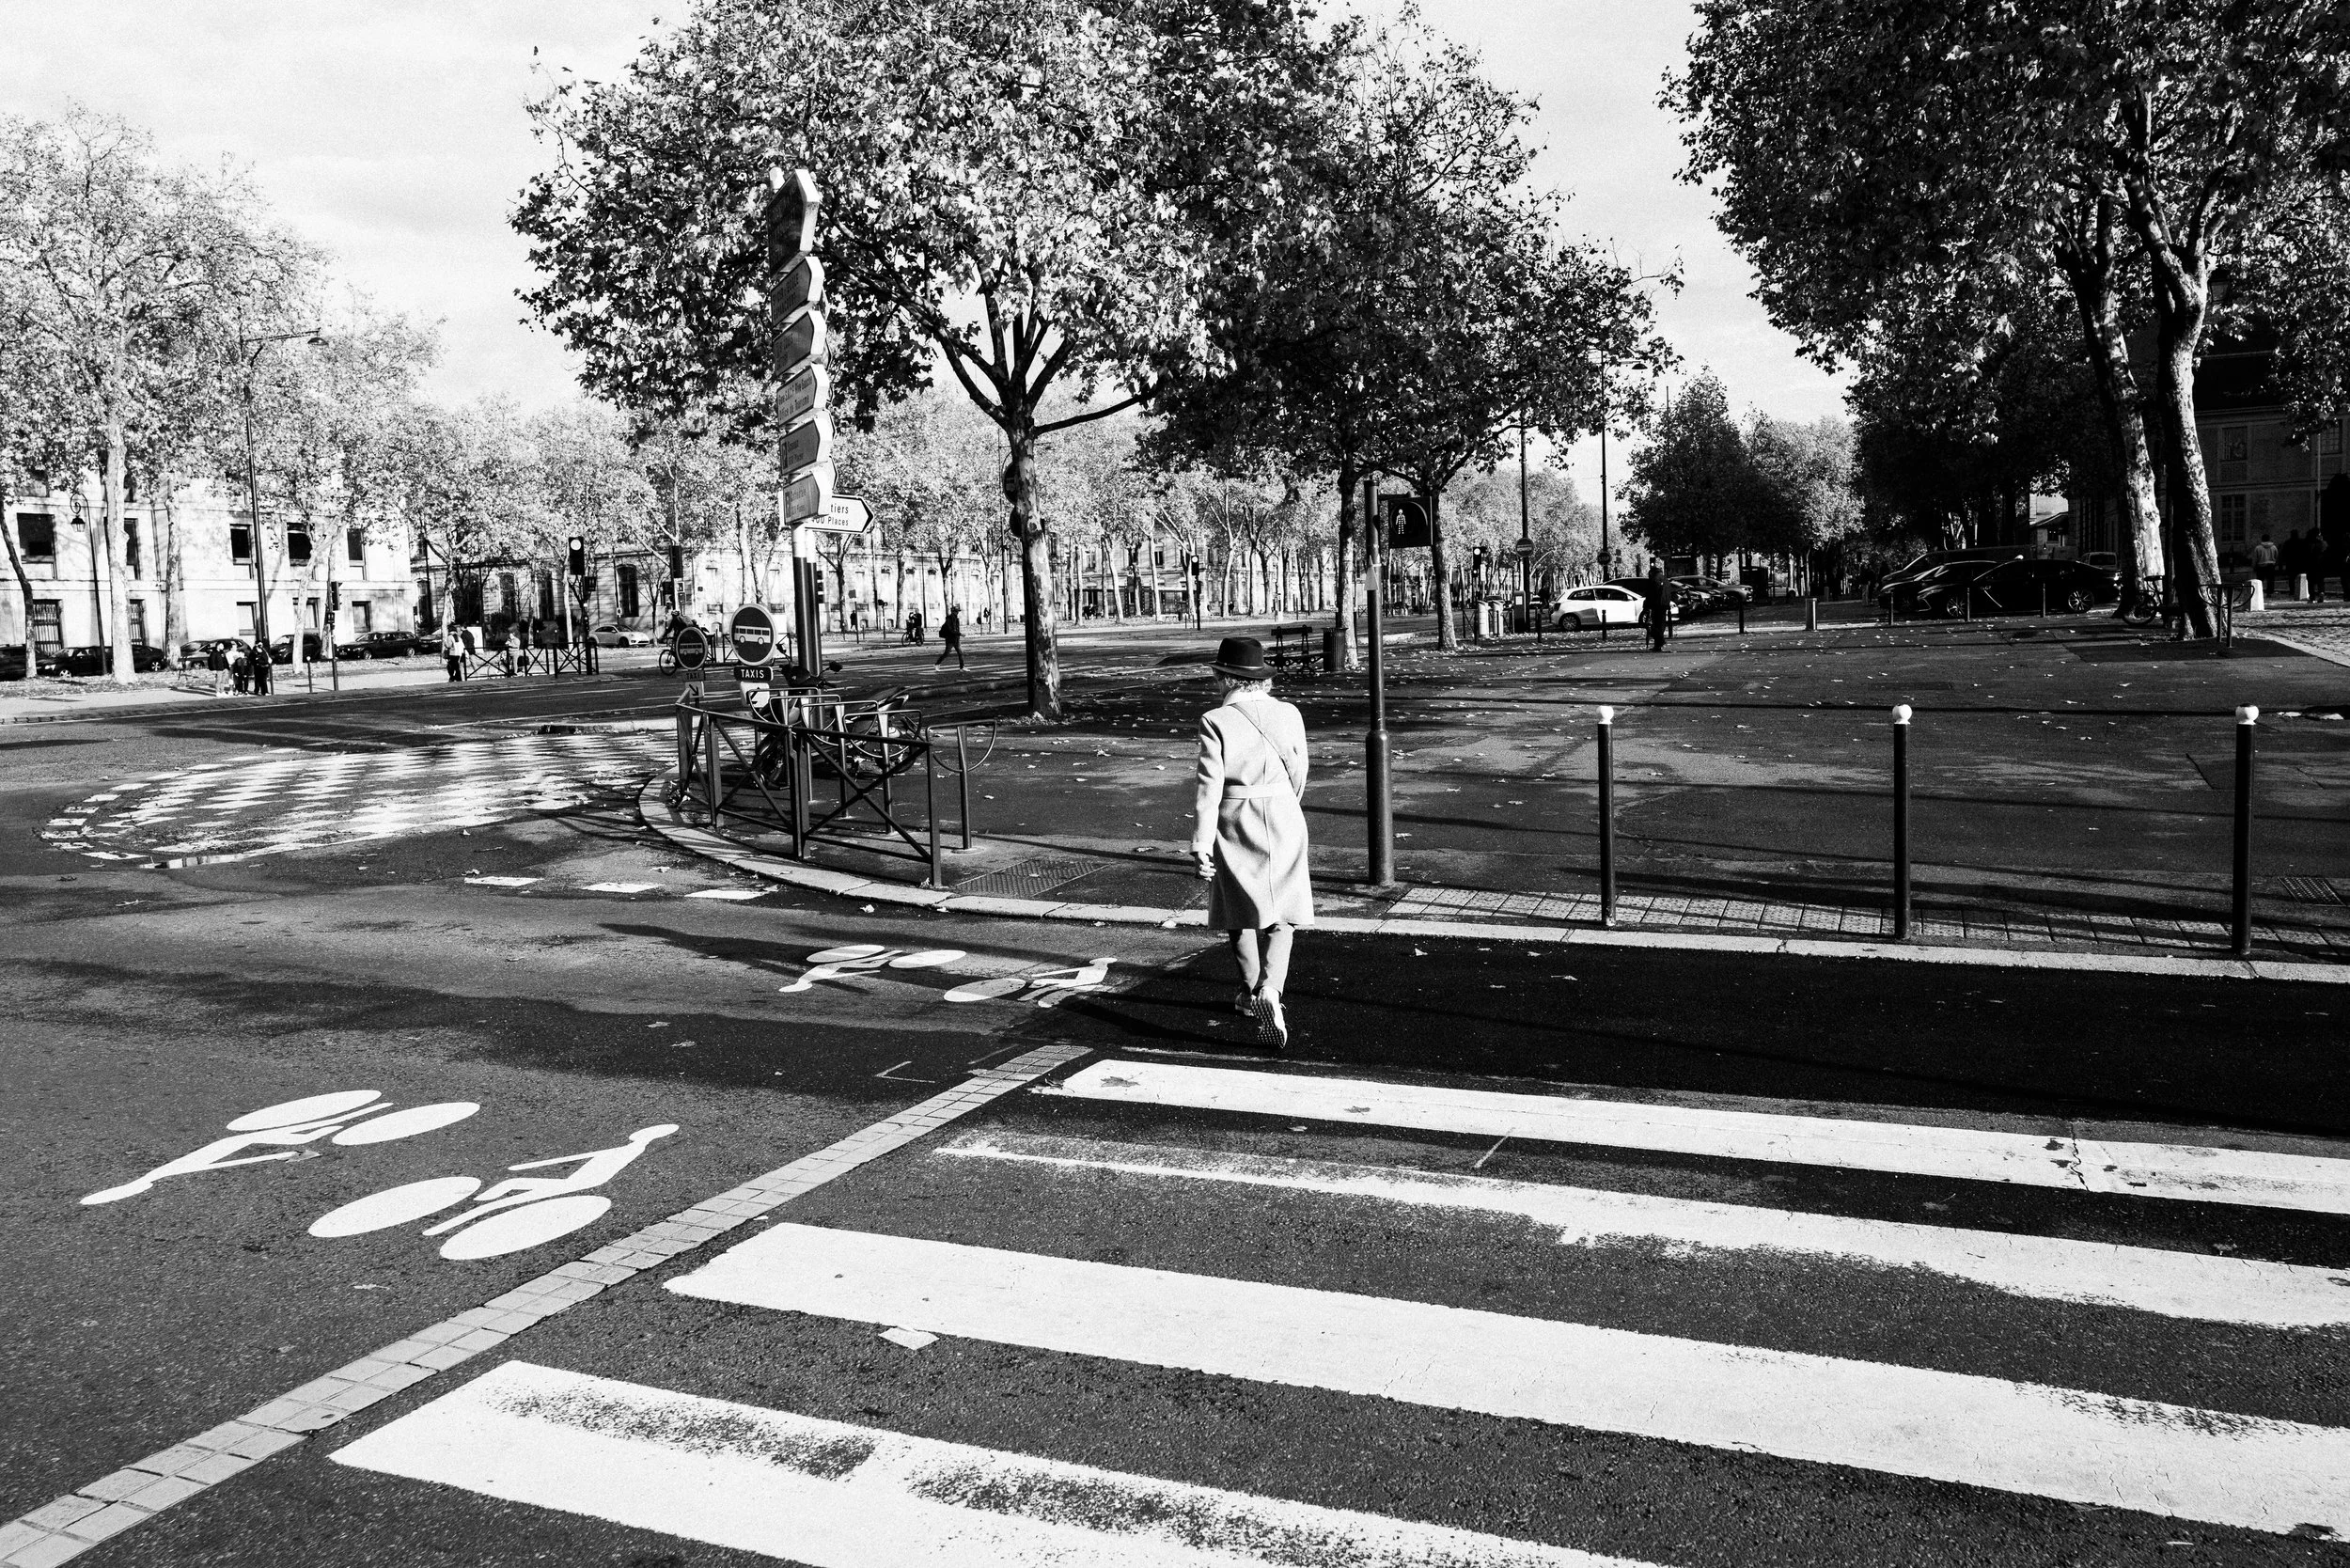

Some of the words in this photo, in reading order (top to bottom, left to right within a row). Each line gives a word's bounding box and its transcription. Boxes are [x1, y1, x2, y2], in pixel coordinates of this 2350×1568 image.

[830, 503, 849, 514] tiers
[827, 516, 849, 526] Places
[740, 668, 764, 679] TAXIS
